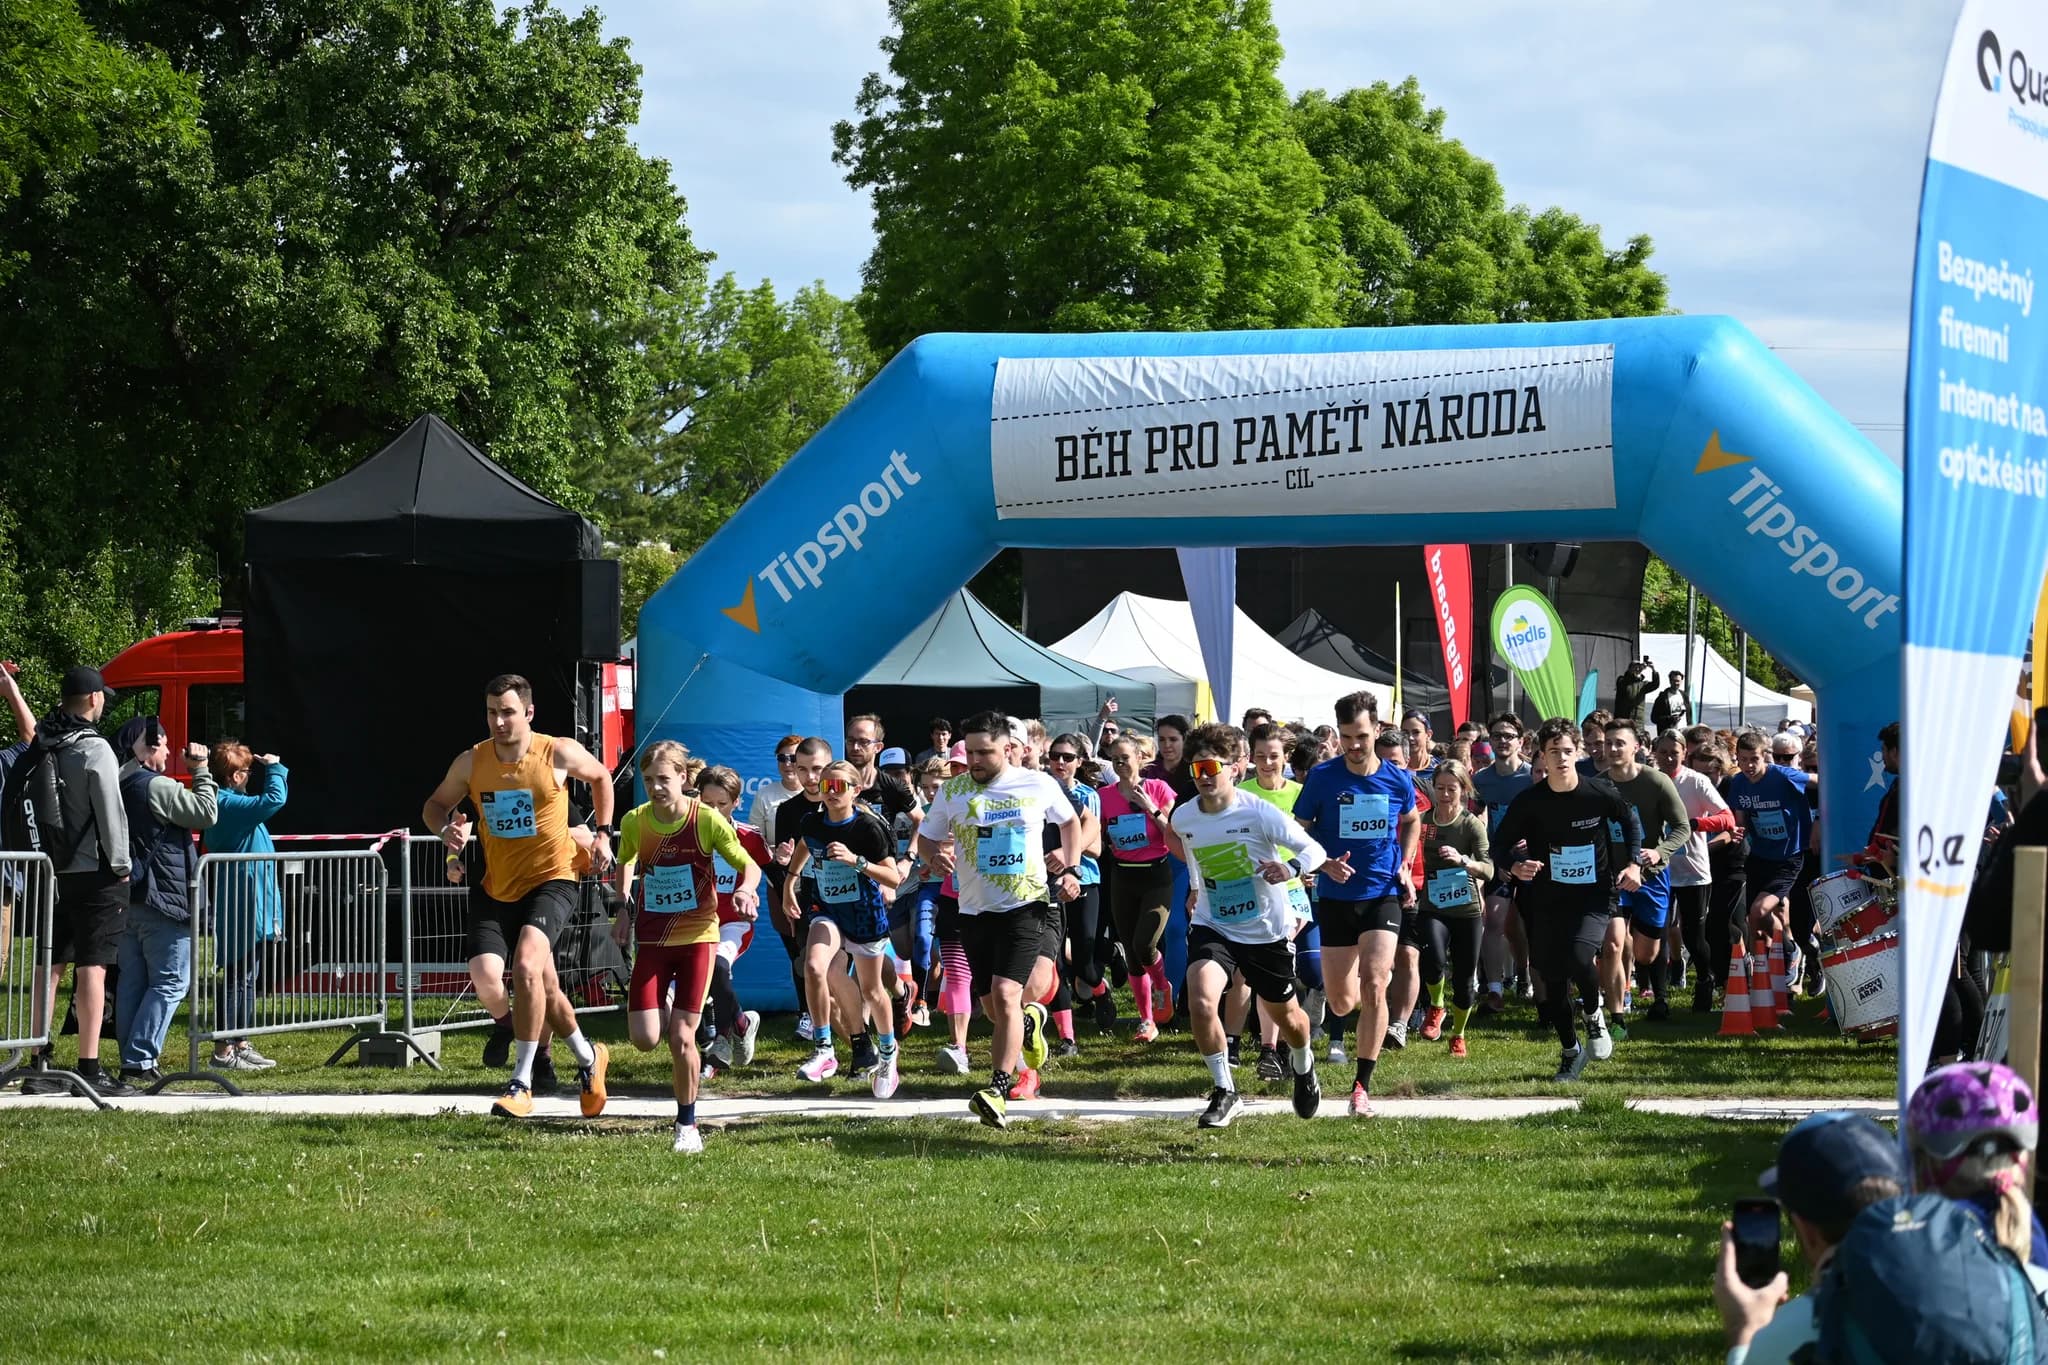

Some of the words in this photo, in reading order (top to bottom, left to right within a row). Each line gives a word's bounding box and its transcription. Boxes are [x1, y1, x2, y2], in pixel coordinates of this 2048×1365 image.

[1938, 240, 2034, 317] Bezpečný
[1938, 304, 2009, 363] firemní
[1939, 368, 2019, 430] internet
[2020, 403, 2048, 437] na
[1055, 426, 1132, 482] BĚH
[1145, 421, 1219, 474] PRO
[1233, 399, 1369, 465] PAMĚŤ
[1381, 386, 1546, 449] NÁRODA
[1286, 466, 1313, 490] CÍL
[758, 449, 921, 603] Tipsport
[1728, 466, 1900, 630] Tipsport
[984, 809, 1021, 821] Tipsport
[496, 816, 533, 831] 5216
[1352, 819, 1386, 832] 5030
[1119, 832, 1146, 846] 5449
[989, 852, 1024, 867] 5234
[1561, 865, 1593, 878] 5287
[655, 889, 693, 905] 5133
[824, 882, 858, 897] 5244
[1439, 887, 1468, 902] 5165
[1219, 900, 1256, 917] 5470
